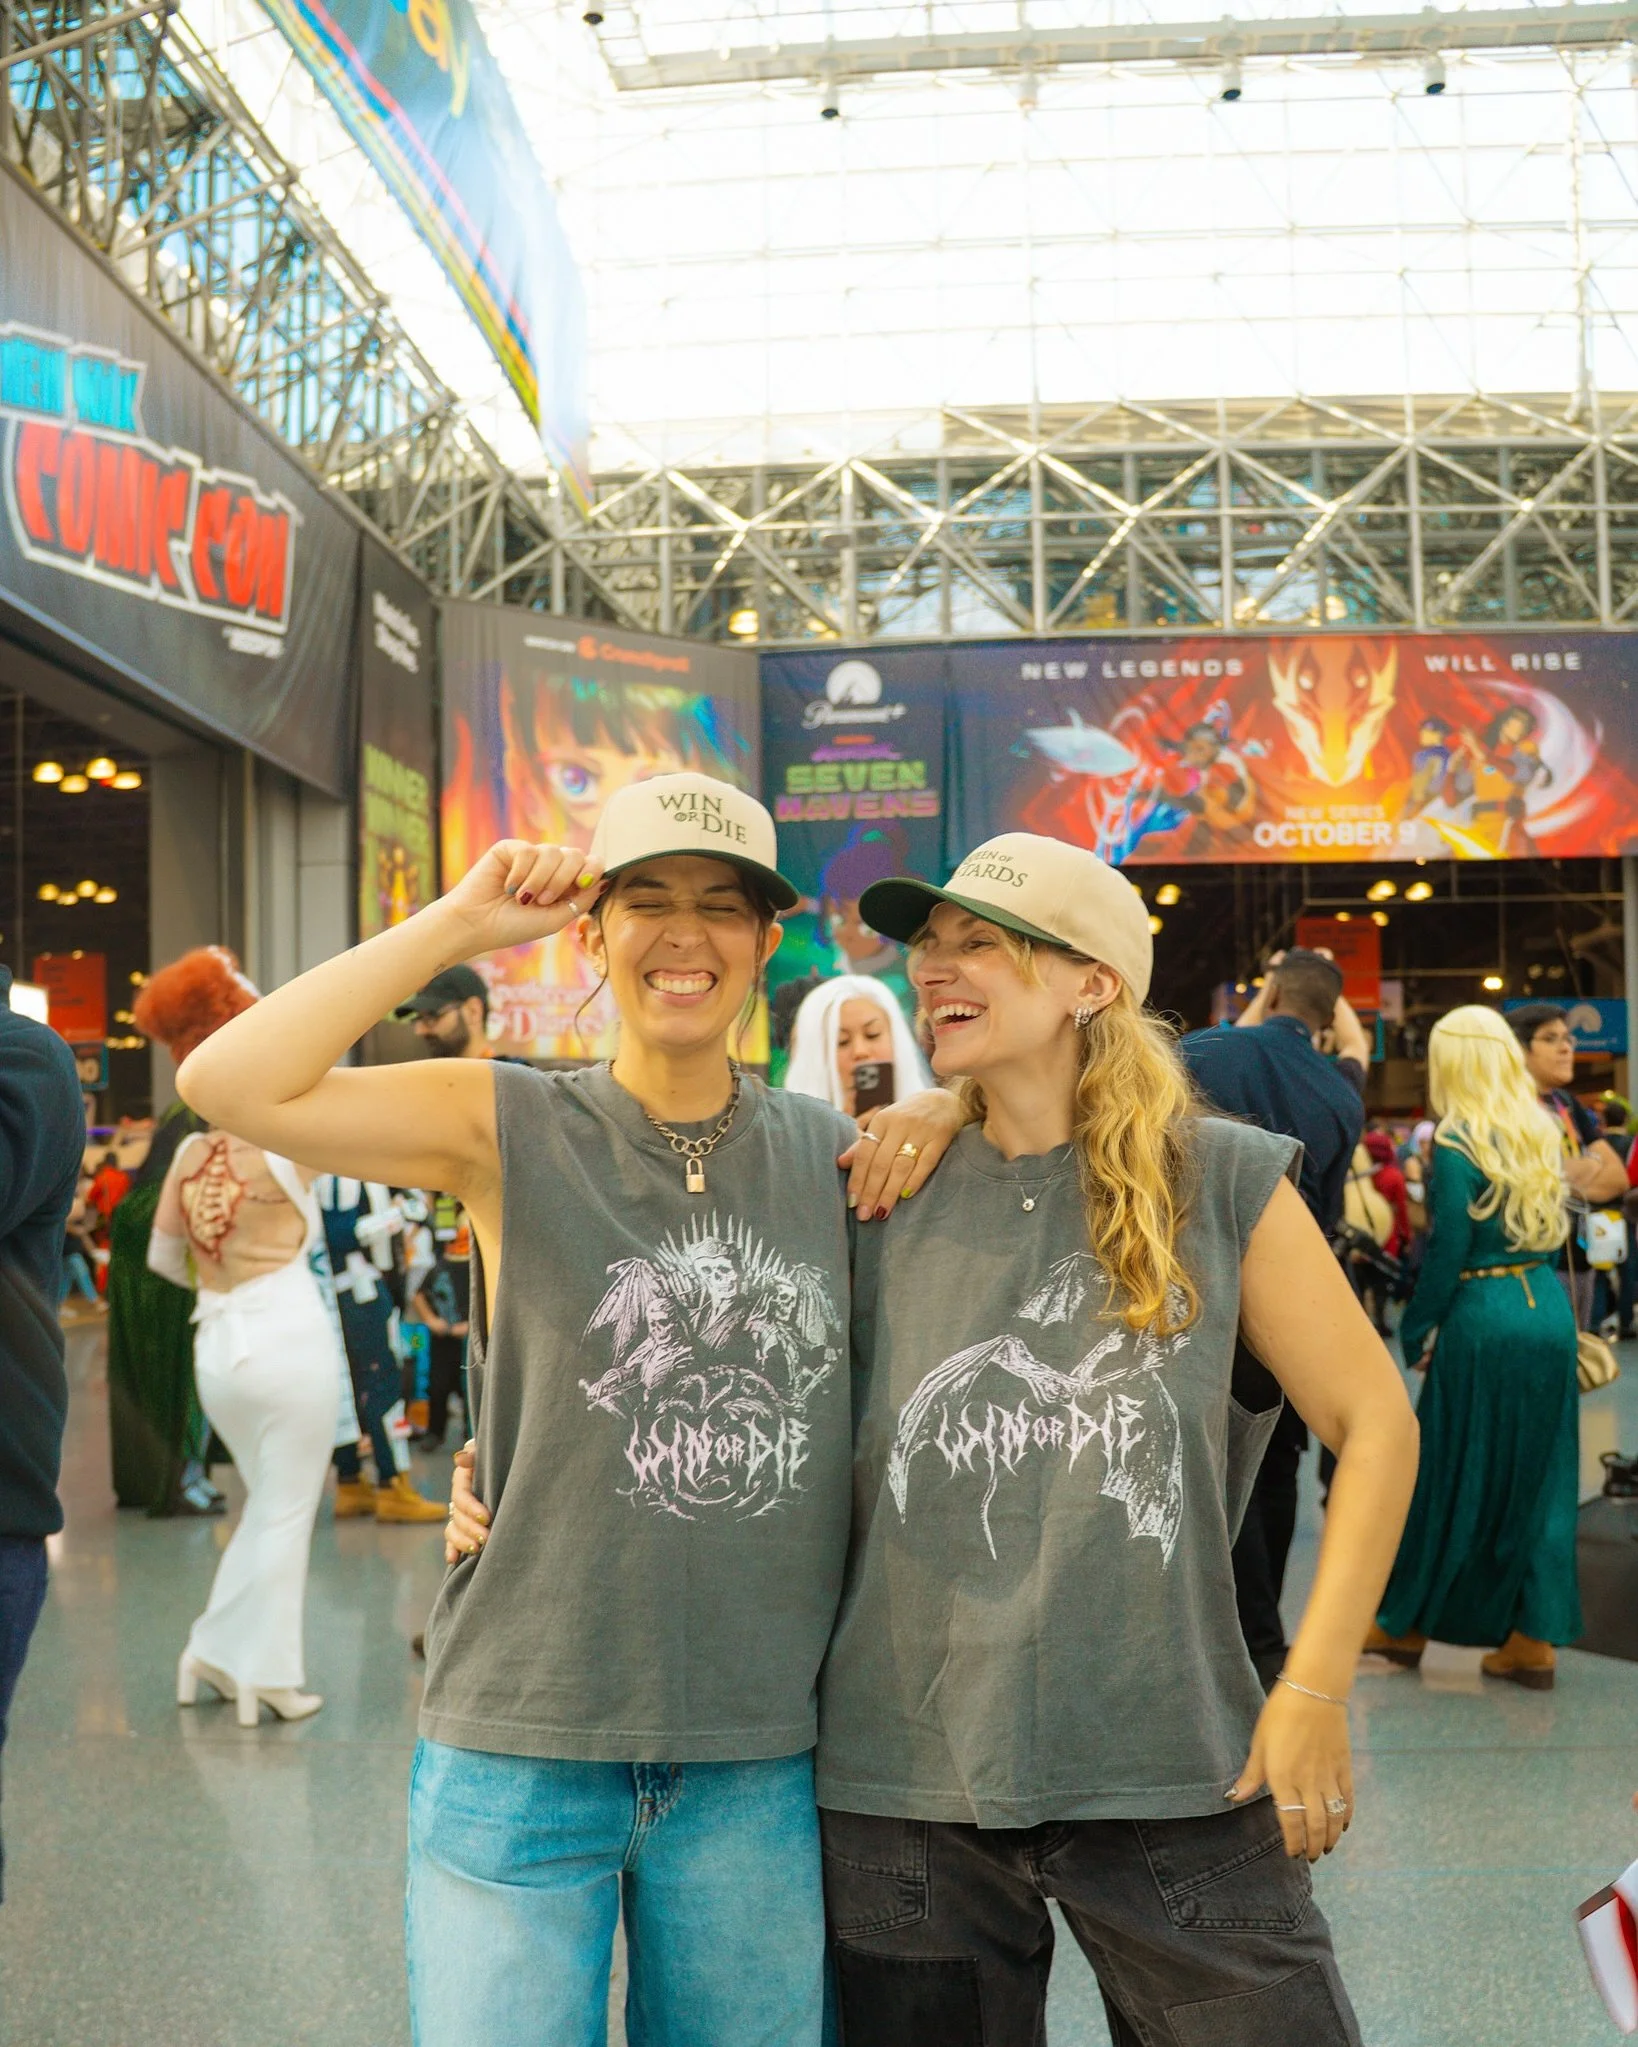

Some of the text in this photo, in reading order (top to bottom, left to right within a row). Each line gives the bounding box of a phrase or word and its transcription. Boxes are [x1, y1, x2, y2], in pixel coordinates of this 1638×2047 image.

[17, 420, 289, 617] COMIC CON
[1021, 658, 1243, 680] NEW LEGENDS
[1424, 652, 1581, 672] WILL RISE
[786, 760, 926, 795] SEVEN
[656, 792, 723, 814] WIN
[701, 812, 747, 845] DIE
[1253, 819, 1417, 848] OCTOBER 9
[934, 1398, 1031, 1480] WIN
[1062, 1392, 1147, 1480] DIE
[624, 1414, 716, 1496] WIN
[743, 1412, 812, 1494] DIE
